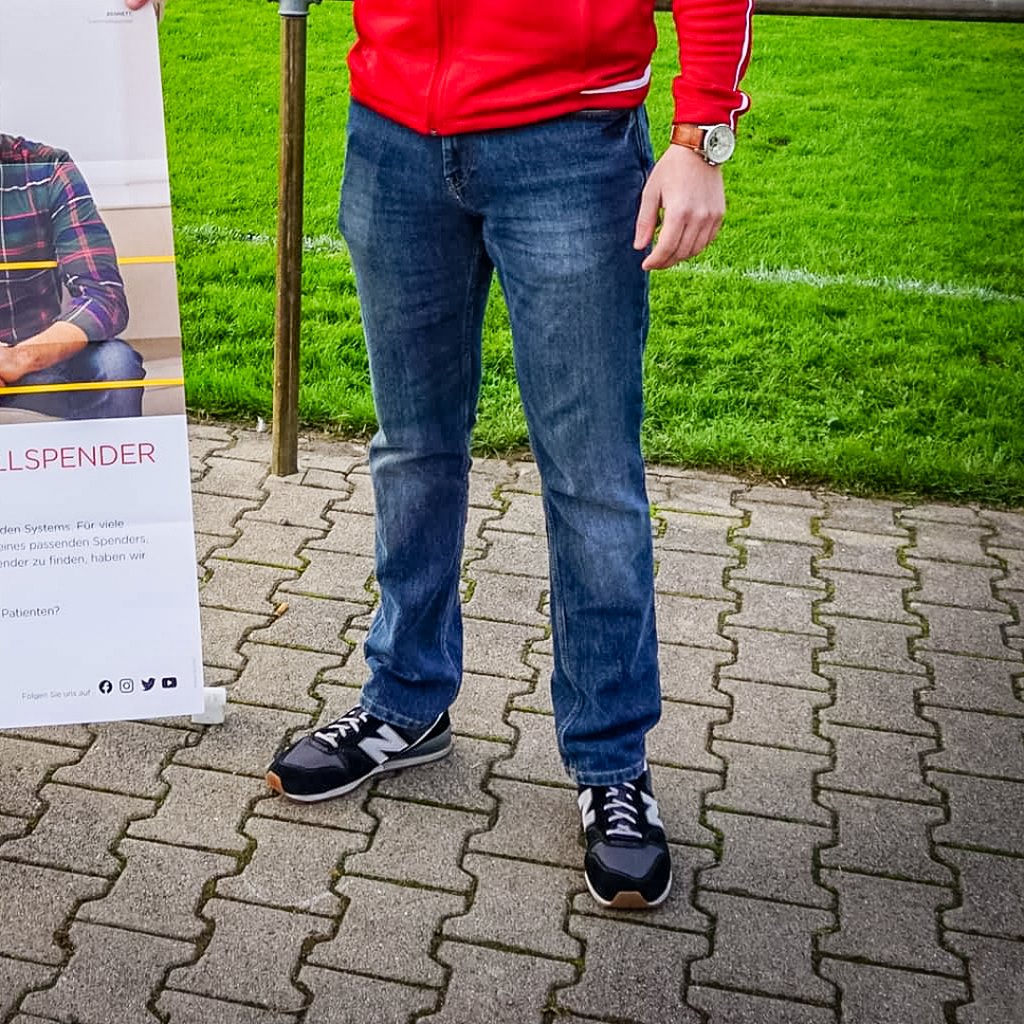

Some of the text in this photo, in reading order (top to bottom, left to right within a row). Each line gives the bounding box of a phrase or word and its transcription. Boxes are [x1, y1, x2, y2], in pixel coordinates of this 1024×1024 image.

[77, 519, 95, 530] Für
[99, 519, 124, 529] viele
[29, 537, 90, 551] passenden
[32, 557, 46, 567] zu
[91, 551, 126, 563] haben
[129, 550, 145, 561] wir
[2, 605, 60, 618] Patienten?
